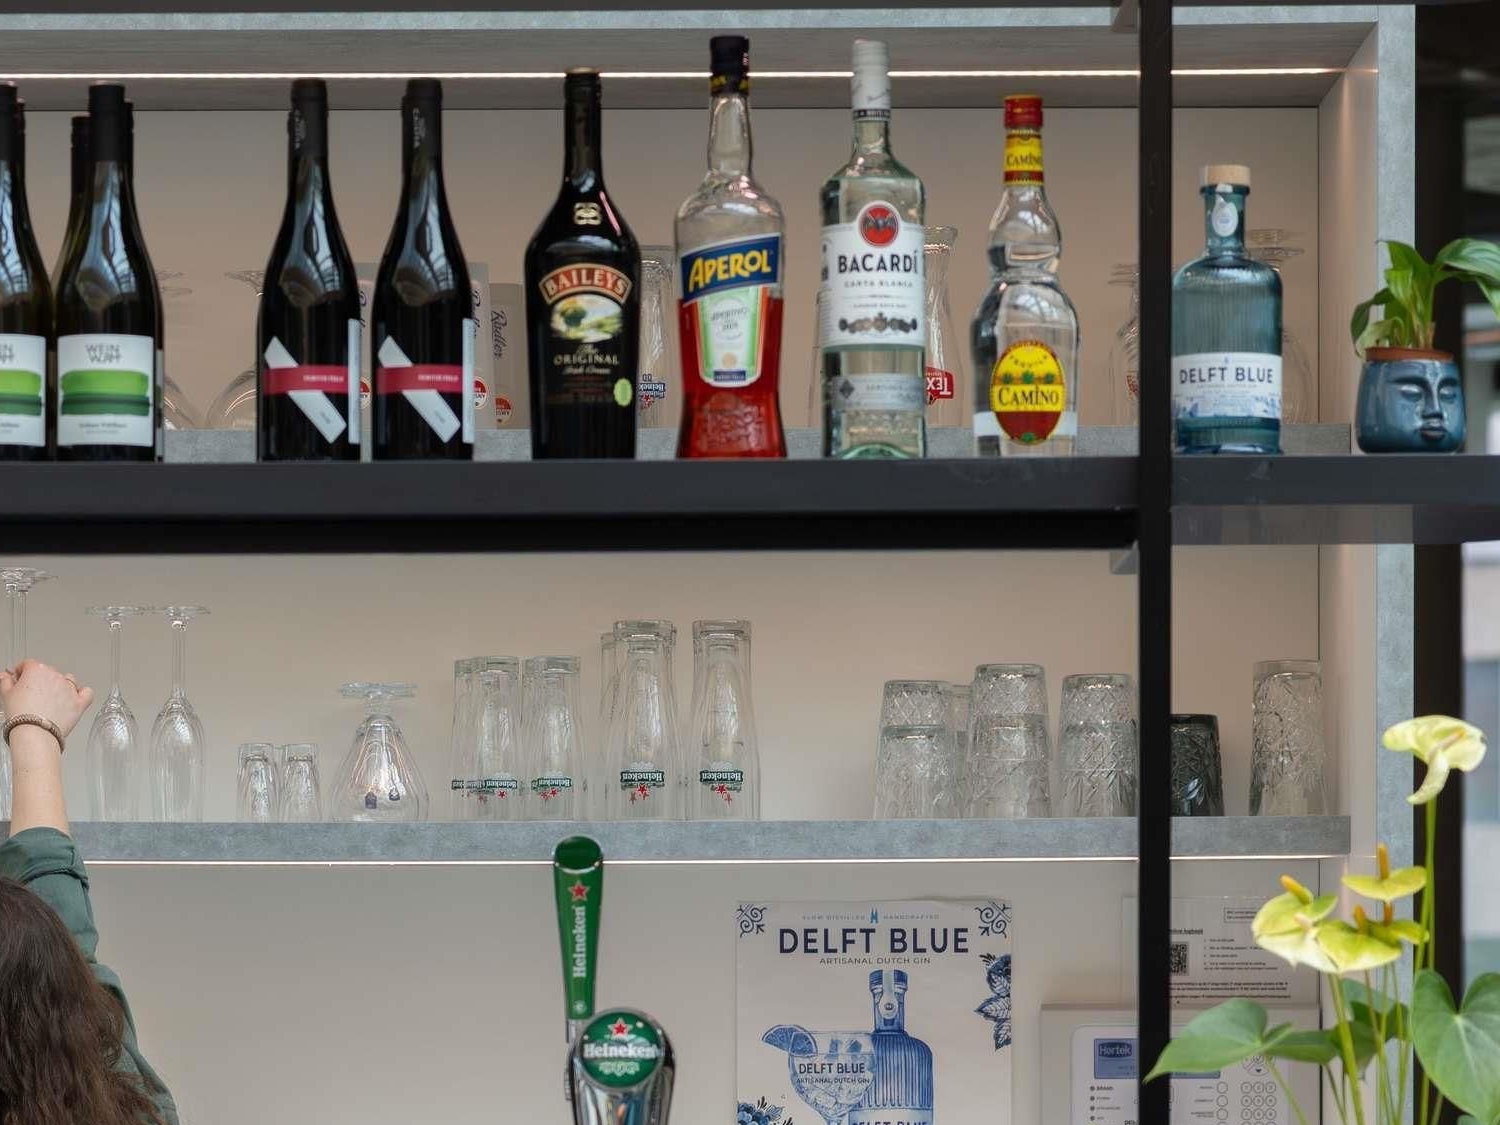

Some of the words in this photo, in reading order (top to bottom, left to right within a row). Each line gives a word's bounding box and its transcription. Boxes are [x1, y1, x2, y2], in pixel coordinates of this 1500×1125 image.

[688, 248, 772, 292] APEROL
[543, 268, 628, 298] BAILEYS
[553, 354, 619, 366] ORIGINAL
[1180, 367, 1227, 384] DELFT
[1235, 367, 1273, 383] BLUE
[572, 905, 587, 978] Heineken
[779, 928, 876, 953] DELFT
[890, 928, 969, 953] BLUE
[583, 1042, 658, 1059] Heineken
[799, 1063, 833, 1074] DELFT
[837, 1063, 865, 1073] BLUE
